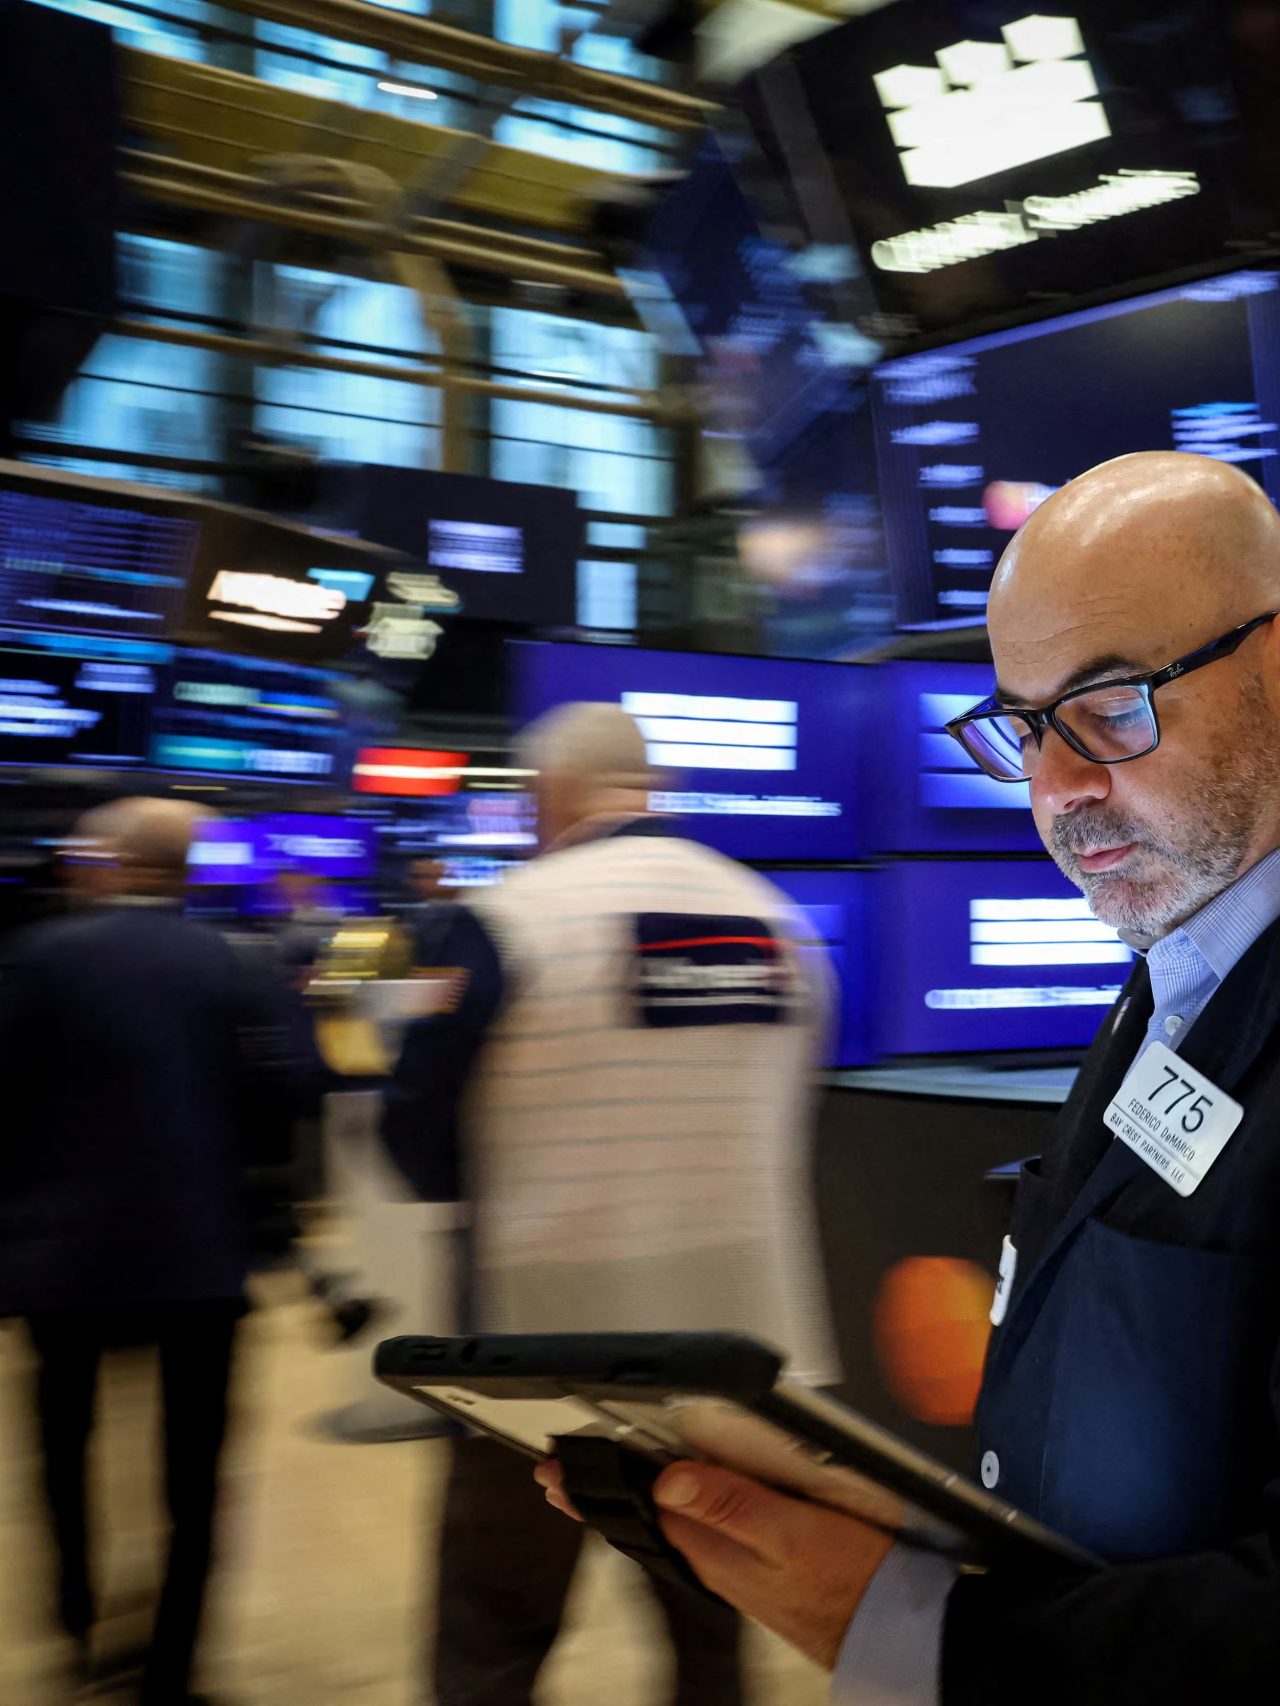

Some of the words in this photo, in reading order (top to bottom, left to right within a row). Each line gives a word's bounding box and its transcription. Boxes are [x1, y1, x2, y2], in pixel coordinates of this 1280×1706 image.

[1110, 1112, 1123, 1128] BAY
[1122, 1124, 1141, 1143] CREST
[1128, 1099, 1161, 1130] FEDERICO
[1160, 1128, 1195, 1161] DeMARCO
[1148, 1065, 1213, 1133] 775
